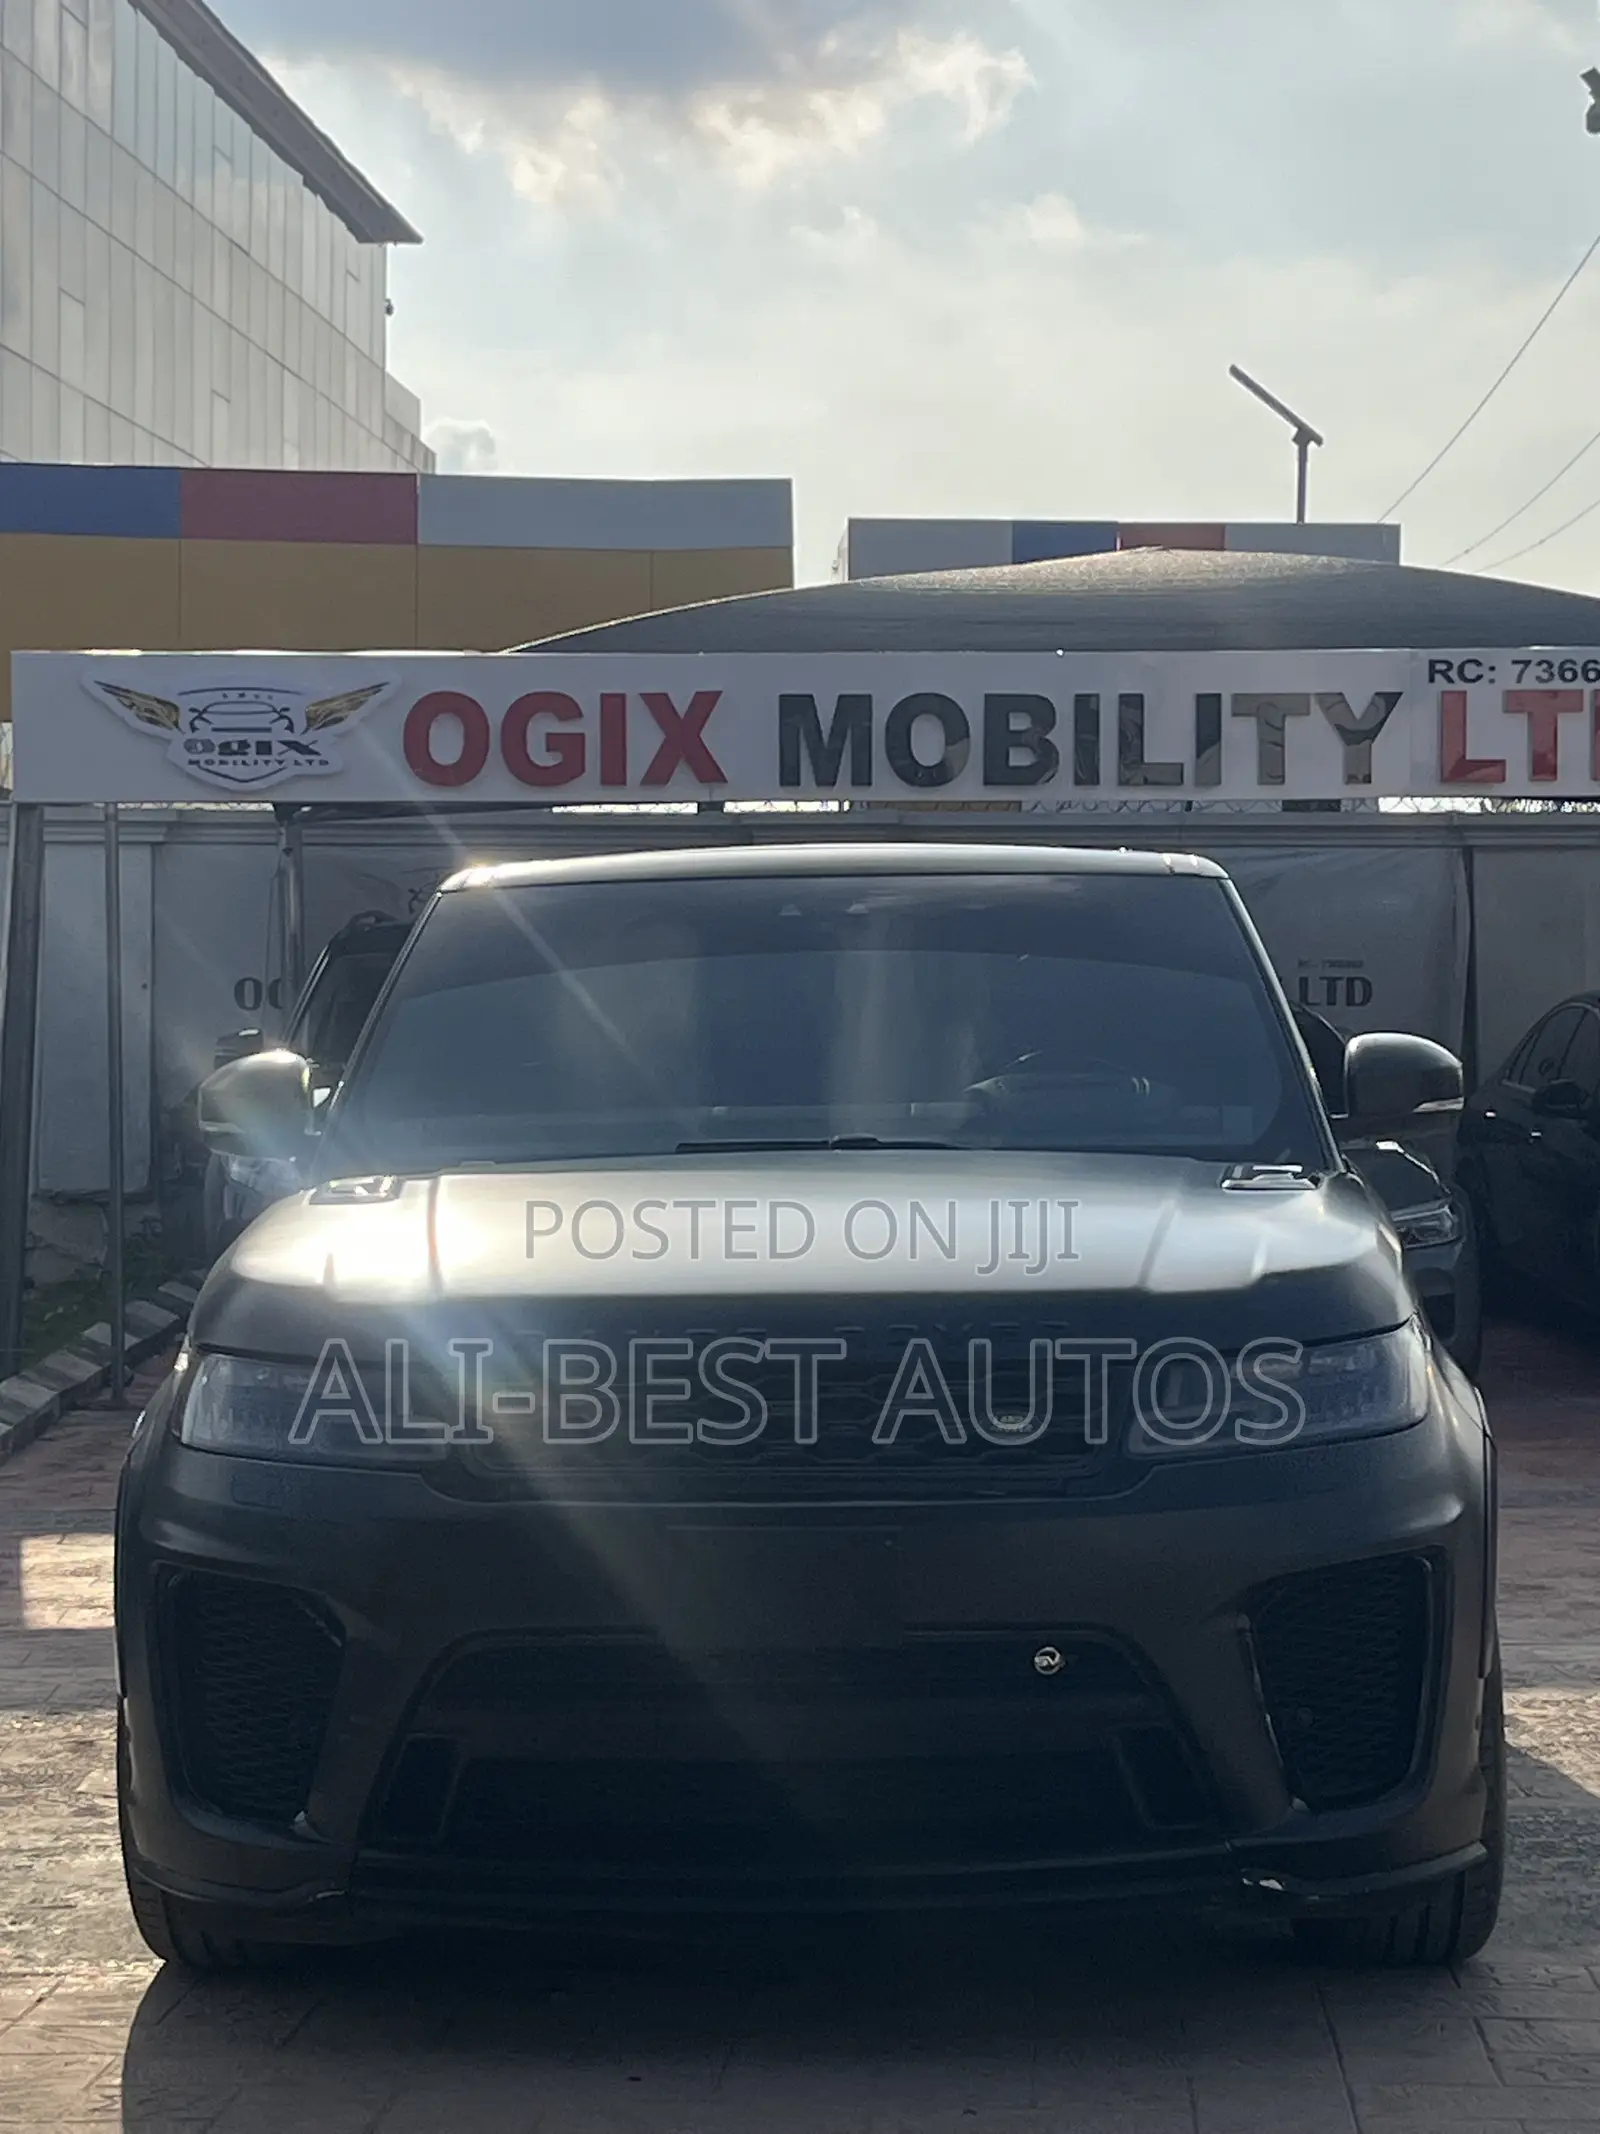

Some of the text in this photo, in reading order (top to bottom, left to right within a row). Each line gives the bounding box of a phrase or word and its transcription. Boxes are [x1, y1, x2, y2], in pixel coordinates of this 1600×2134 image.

[1428, 658, 1496, 684] RC:
[403, 689, 1600, 787] OGIX MOBILITY LT
[1298, 976, 1373, 1007] LTD
